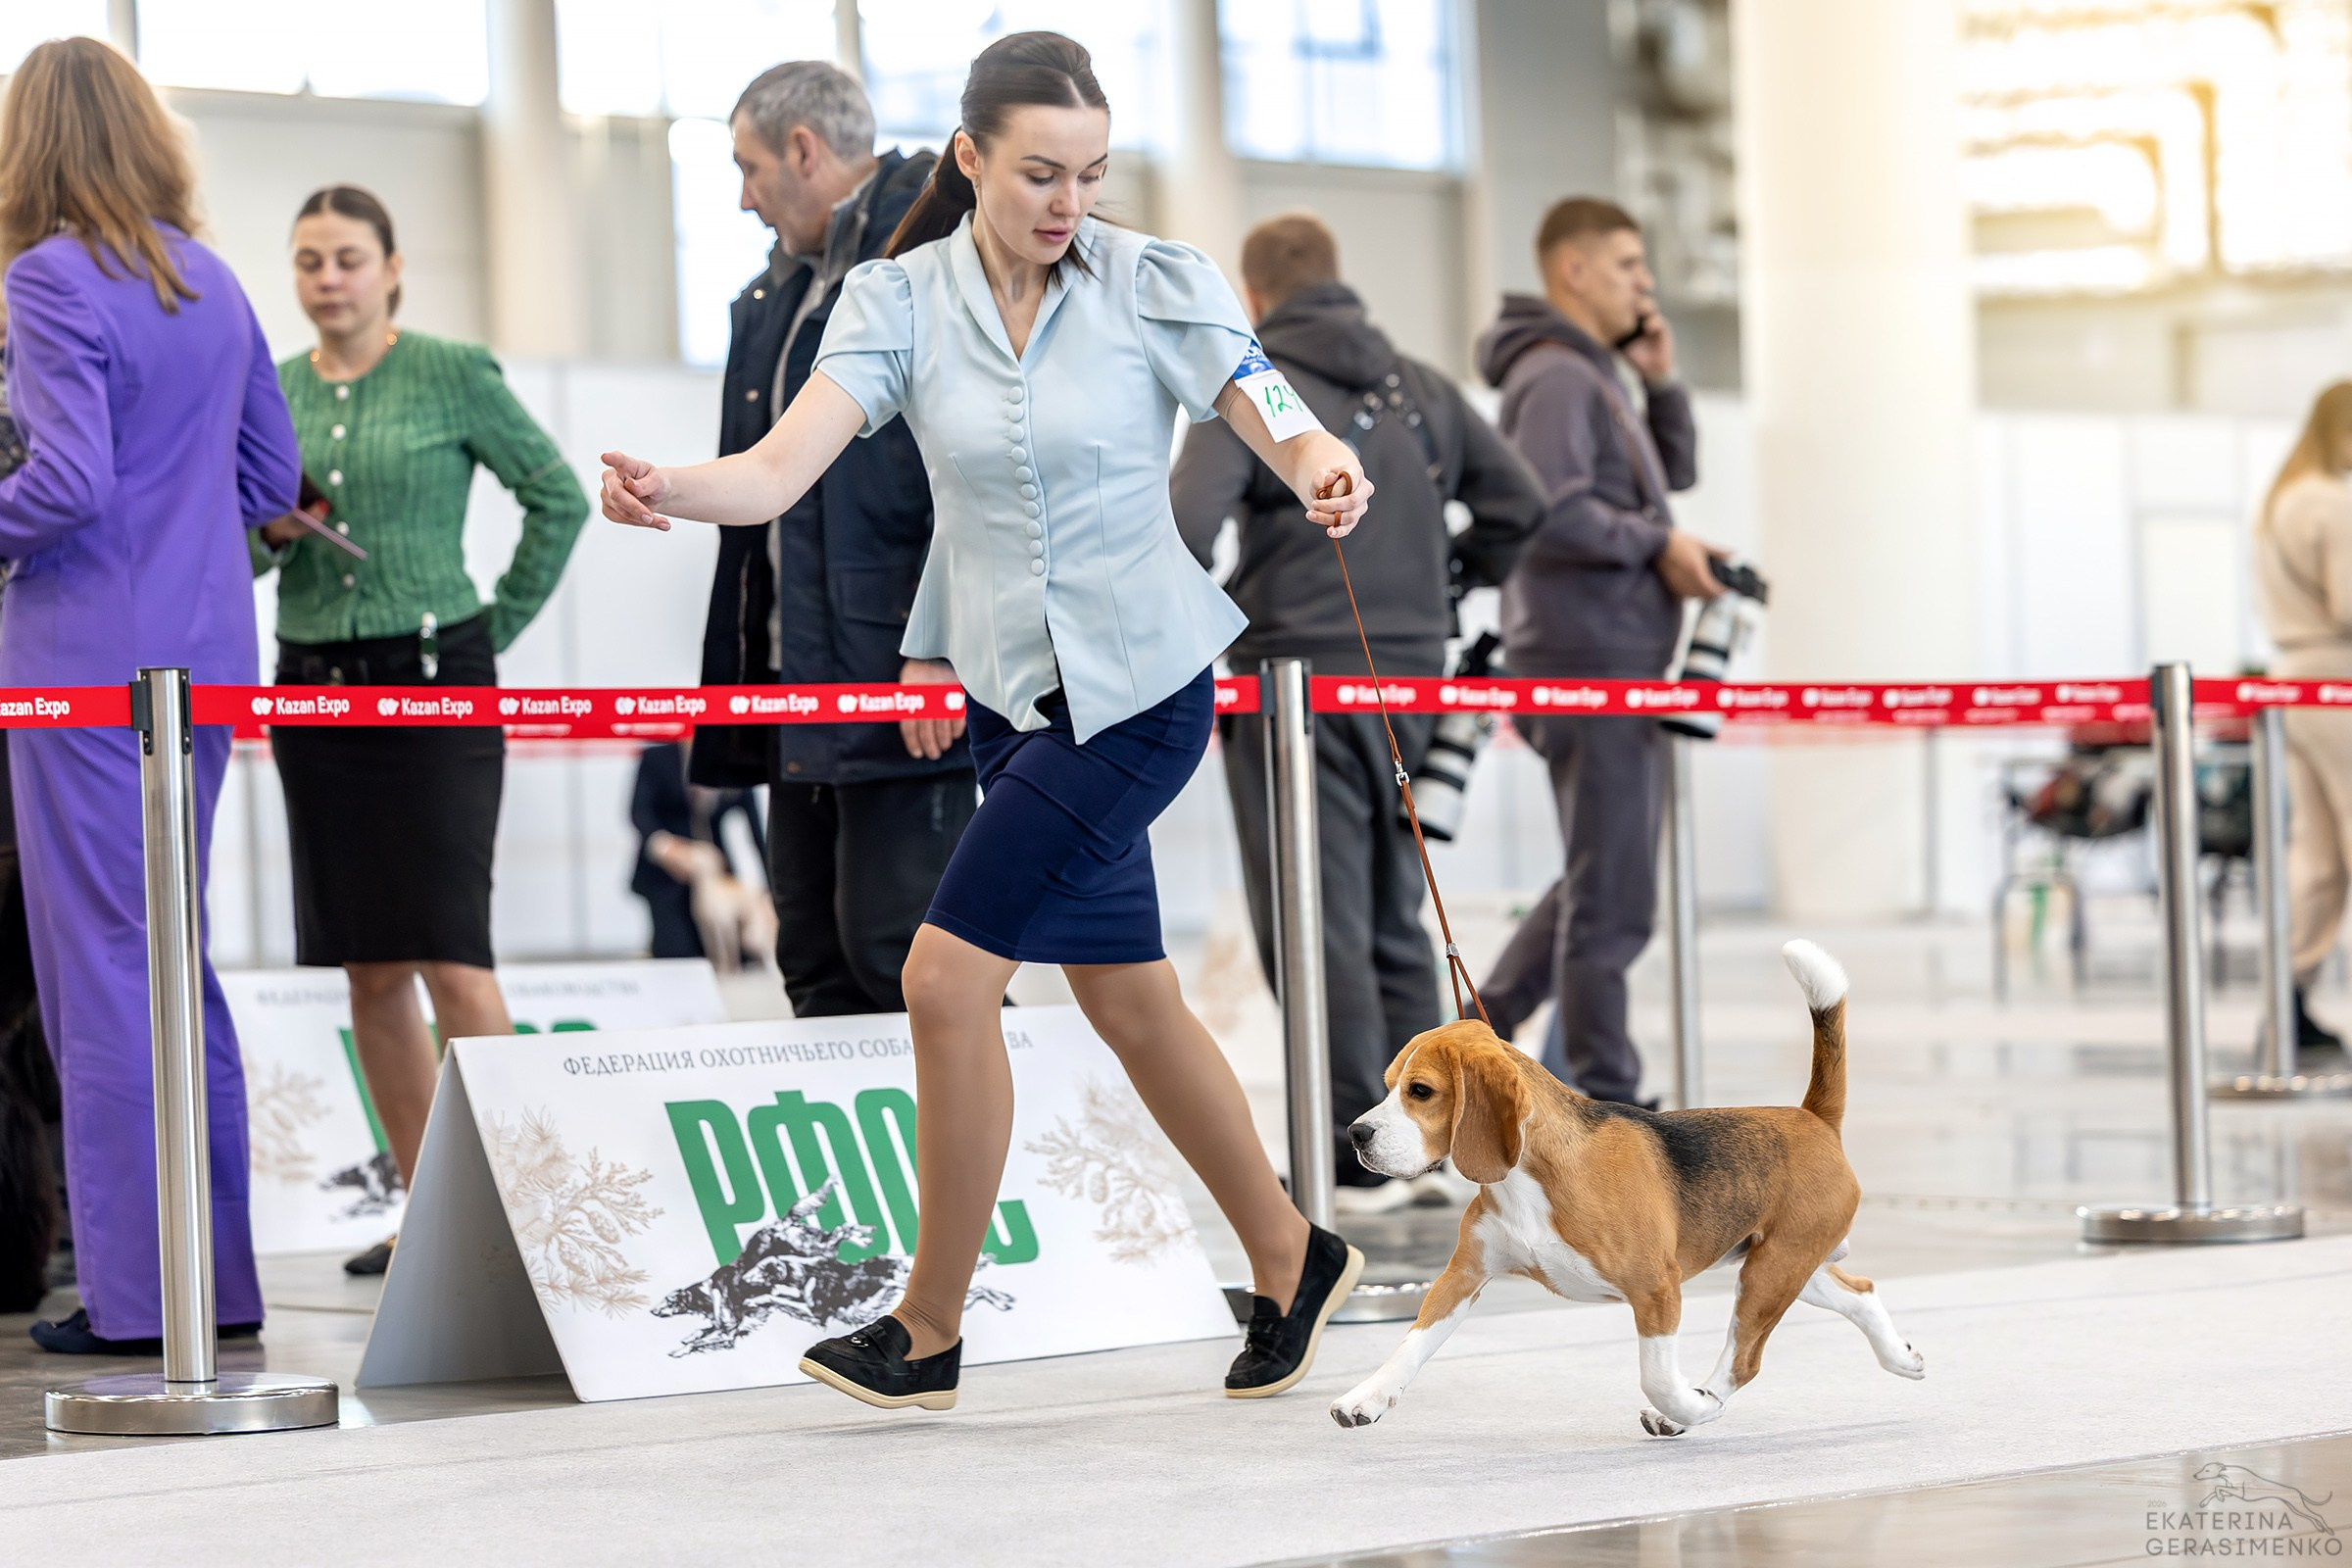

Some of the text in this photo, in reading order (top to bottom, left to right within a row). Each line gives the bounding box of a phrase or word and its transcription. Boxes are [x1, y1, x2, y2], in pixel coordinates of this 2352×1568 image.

[0, 697, 71, 720] azan Expo
[275, 695, 351, 718] Kazan Expo
[401, 696, 474, 719] Kazan Expo
[521, 695, 593, 718] Kazan Expo
[637, 694, 707, 717] Kazan Expo
[563, 1050, 696, 1077] ФЕДЕРАЦИЯ
[700, 1039, 855, 1068] ОХОТНИЧЬЕГО
